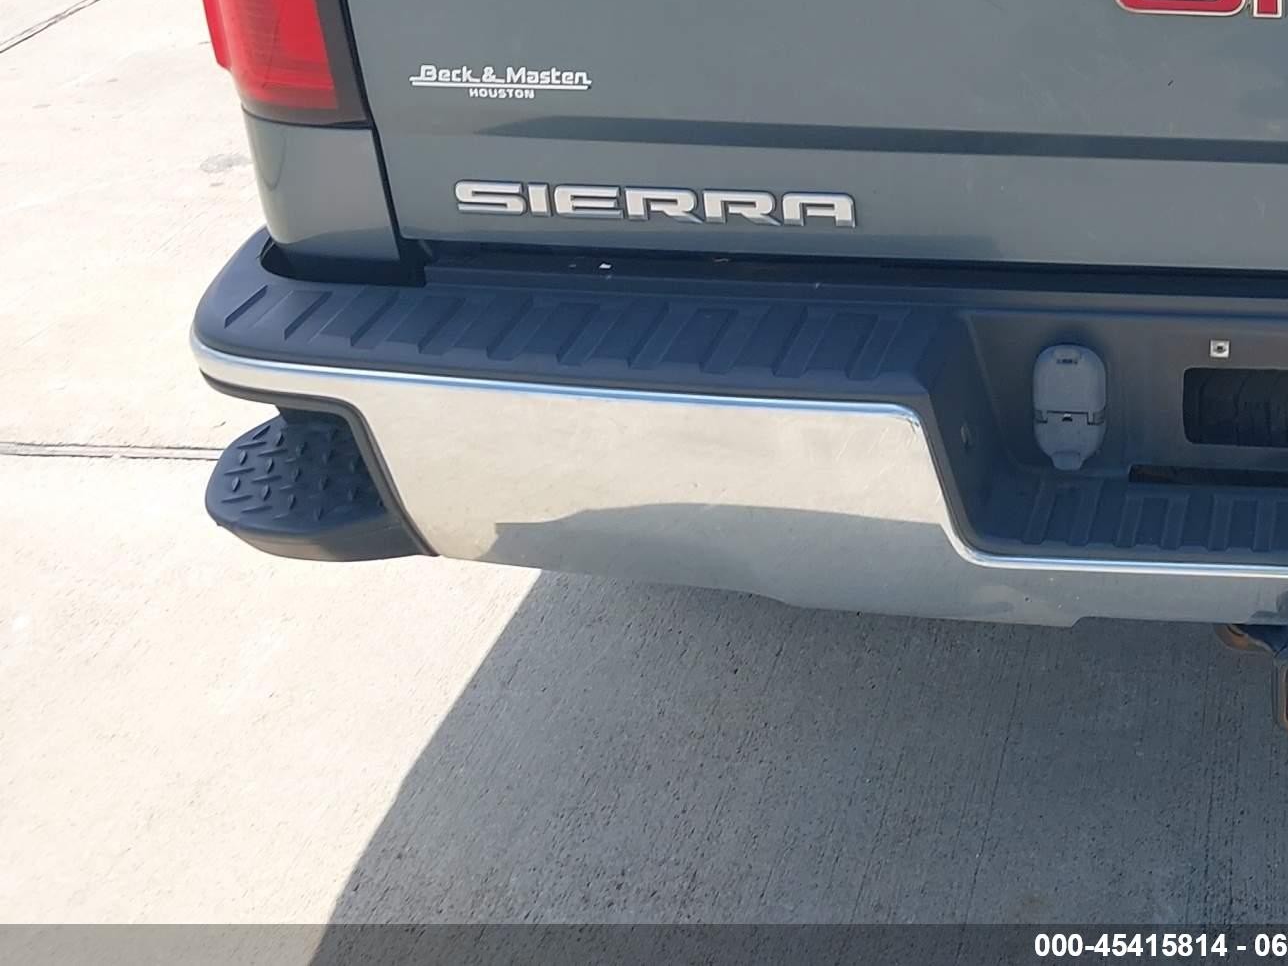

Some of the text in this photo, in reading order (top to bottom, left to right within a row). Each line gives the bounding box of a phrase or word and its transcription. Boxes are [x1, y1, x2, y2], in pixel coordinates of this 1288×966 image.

[409, 65, 592, 85] Beck & Masten
[469, 88, 535, 99] HOUSTON
[454, 179, 857, 229] SIERRA
